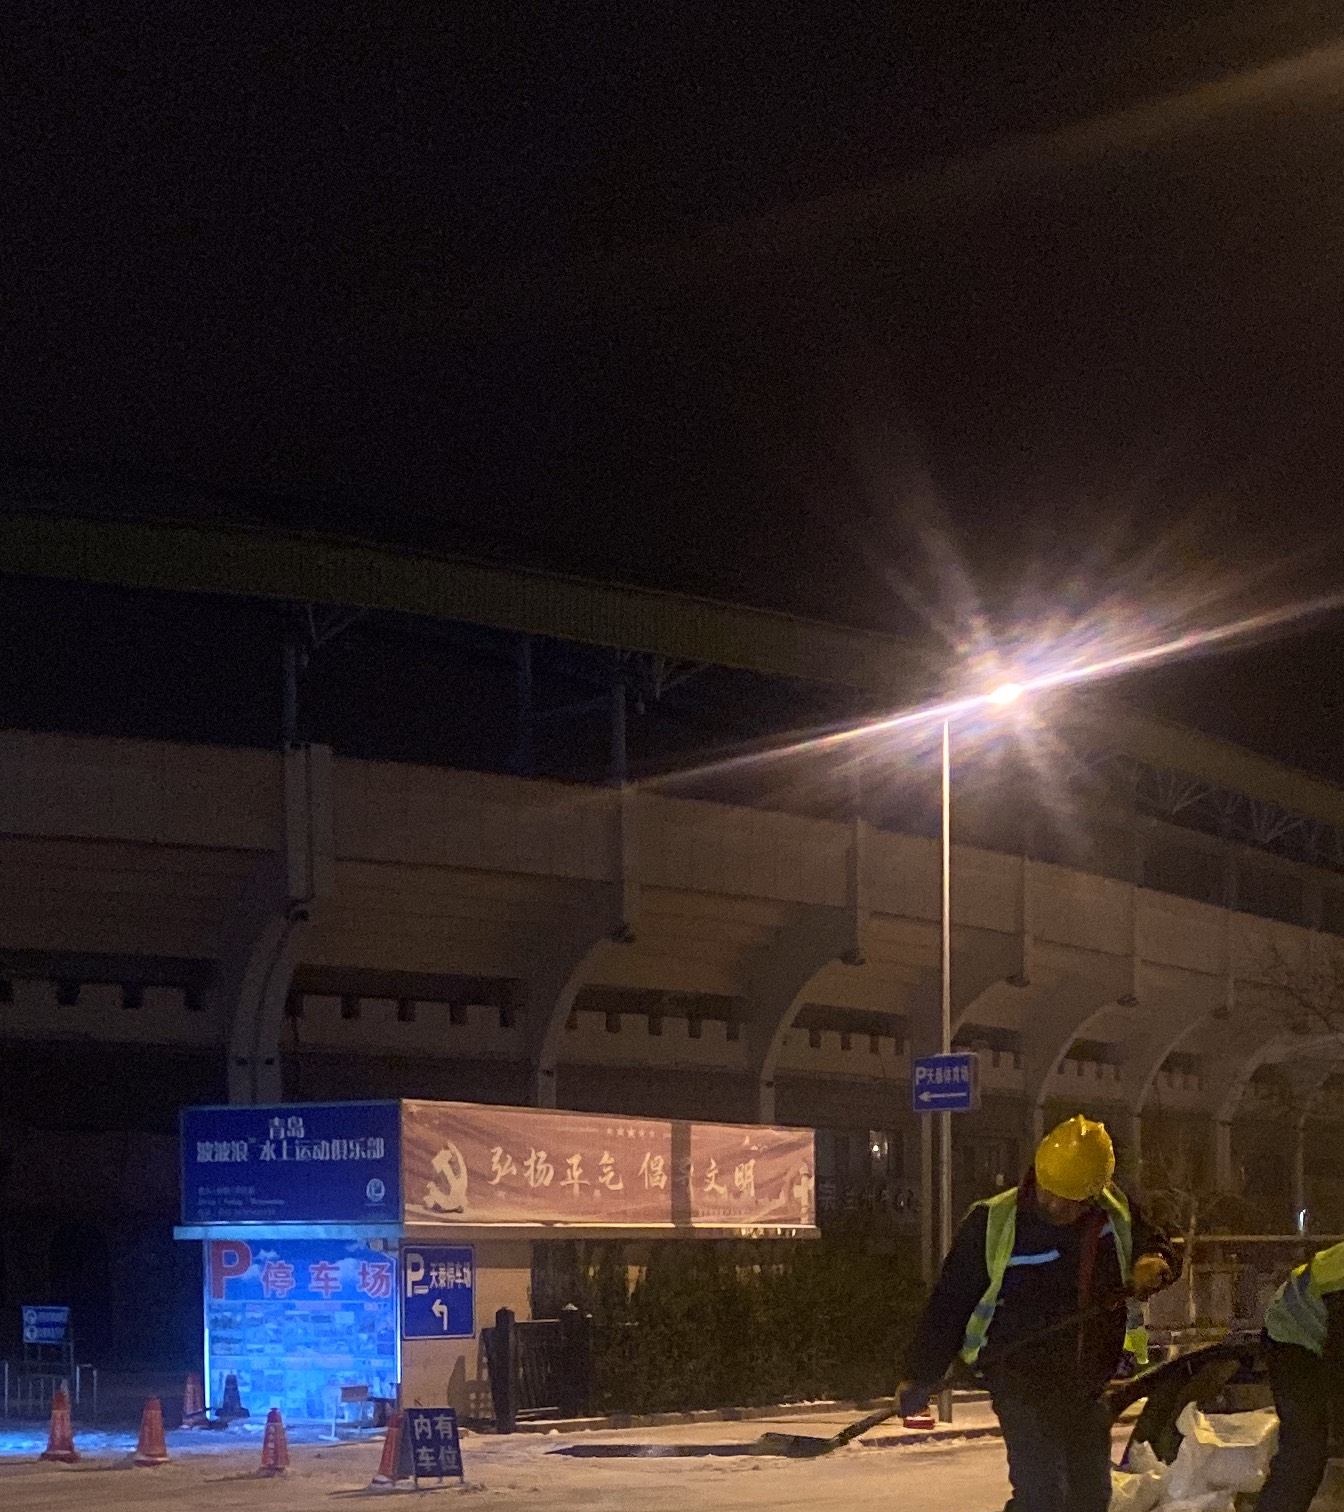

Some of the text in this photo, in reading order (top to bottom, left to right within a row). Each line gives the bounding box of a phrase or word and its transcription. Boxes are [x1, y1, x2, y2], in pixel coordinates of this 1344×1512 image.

[268, 1115, 305, 1139] 青岛
[487, 1146, 624, 1196] 弘扬正气
[211, 1239, 393, 1300] P 停车场
[406, 1253, 424, 1298] P
[414, 1413, 455, 1440] 内有
[416, 1445, 459, 1472] 车位
